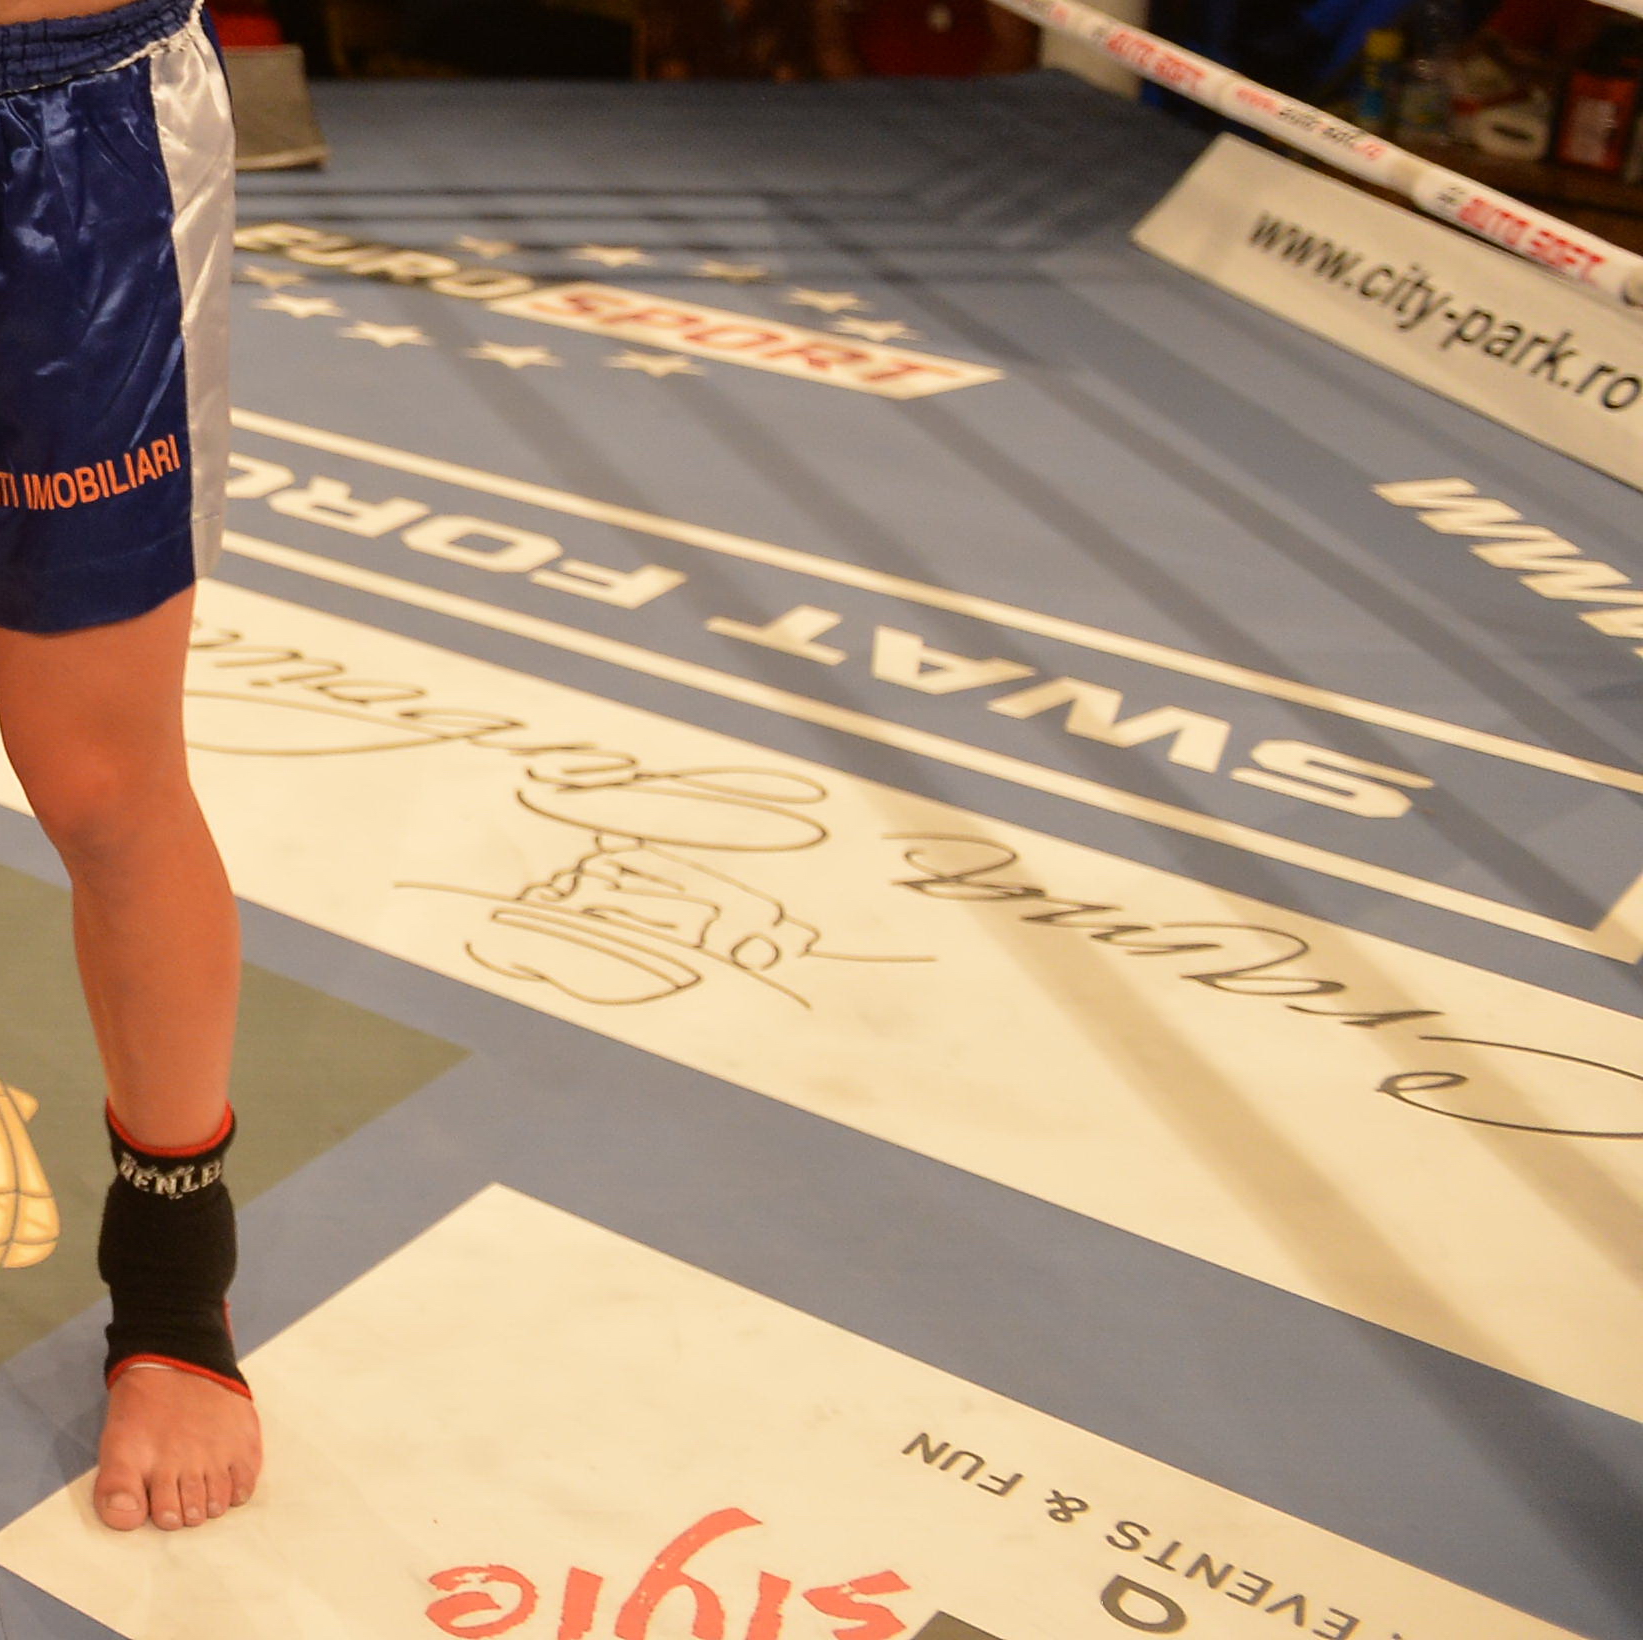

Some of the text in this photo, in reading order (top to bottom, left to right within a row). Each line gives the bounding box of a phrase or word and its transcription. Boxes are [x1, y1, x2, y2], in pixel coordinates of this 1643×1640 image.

[1248, 209, 1643, 410] www.city-park.ro
[23, 433, 182, 511] IMOBILIARI
[708, 605, 1436, 819] SWAT
[882, 830, 1643, 1138] Crama
[902, 1431, 1025, 1498] FUN
[1045, 1494, 1089, 1524] &
[1106, 1518, 1359, 1640] EVENTS
